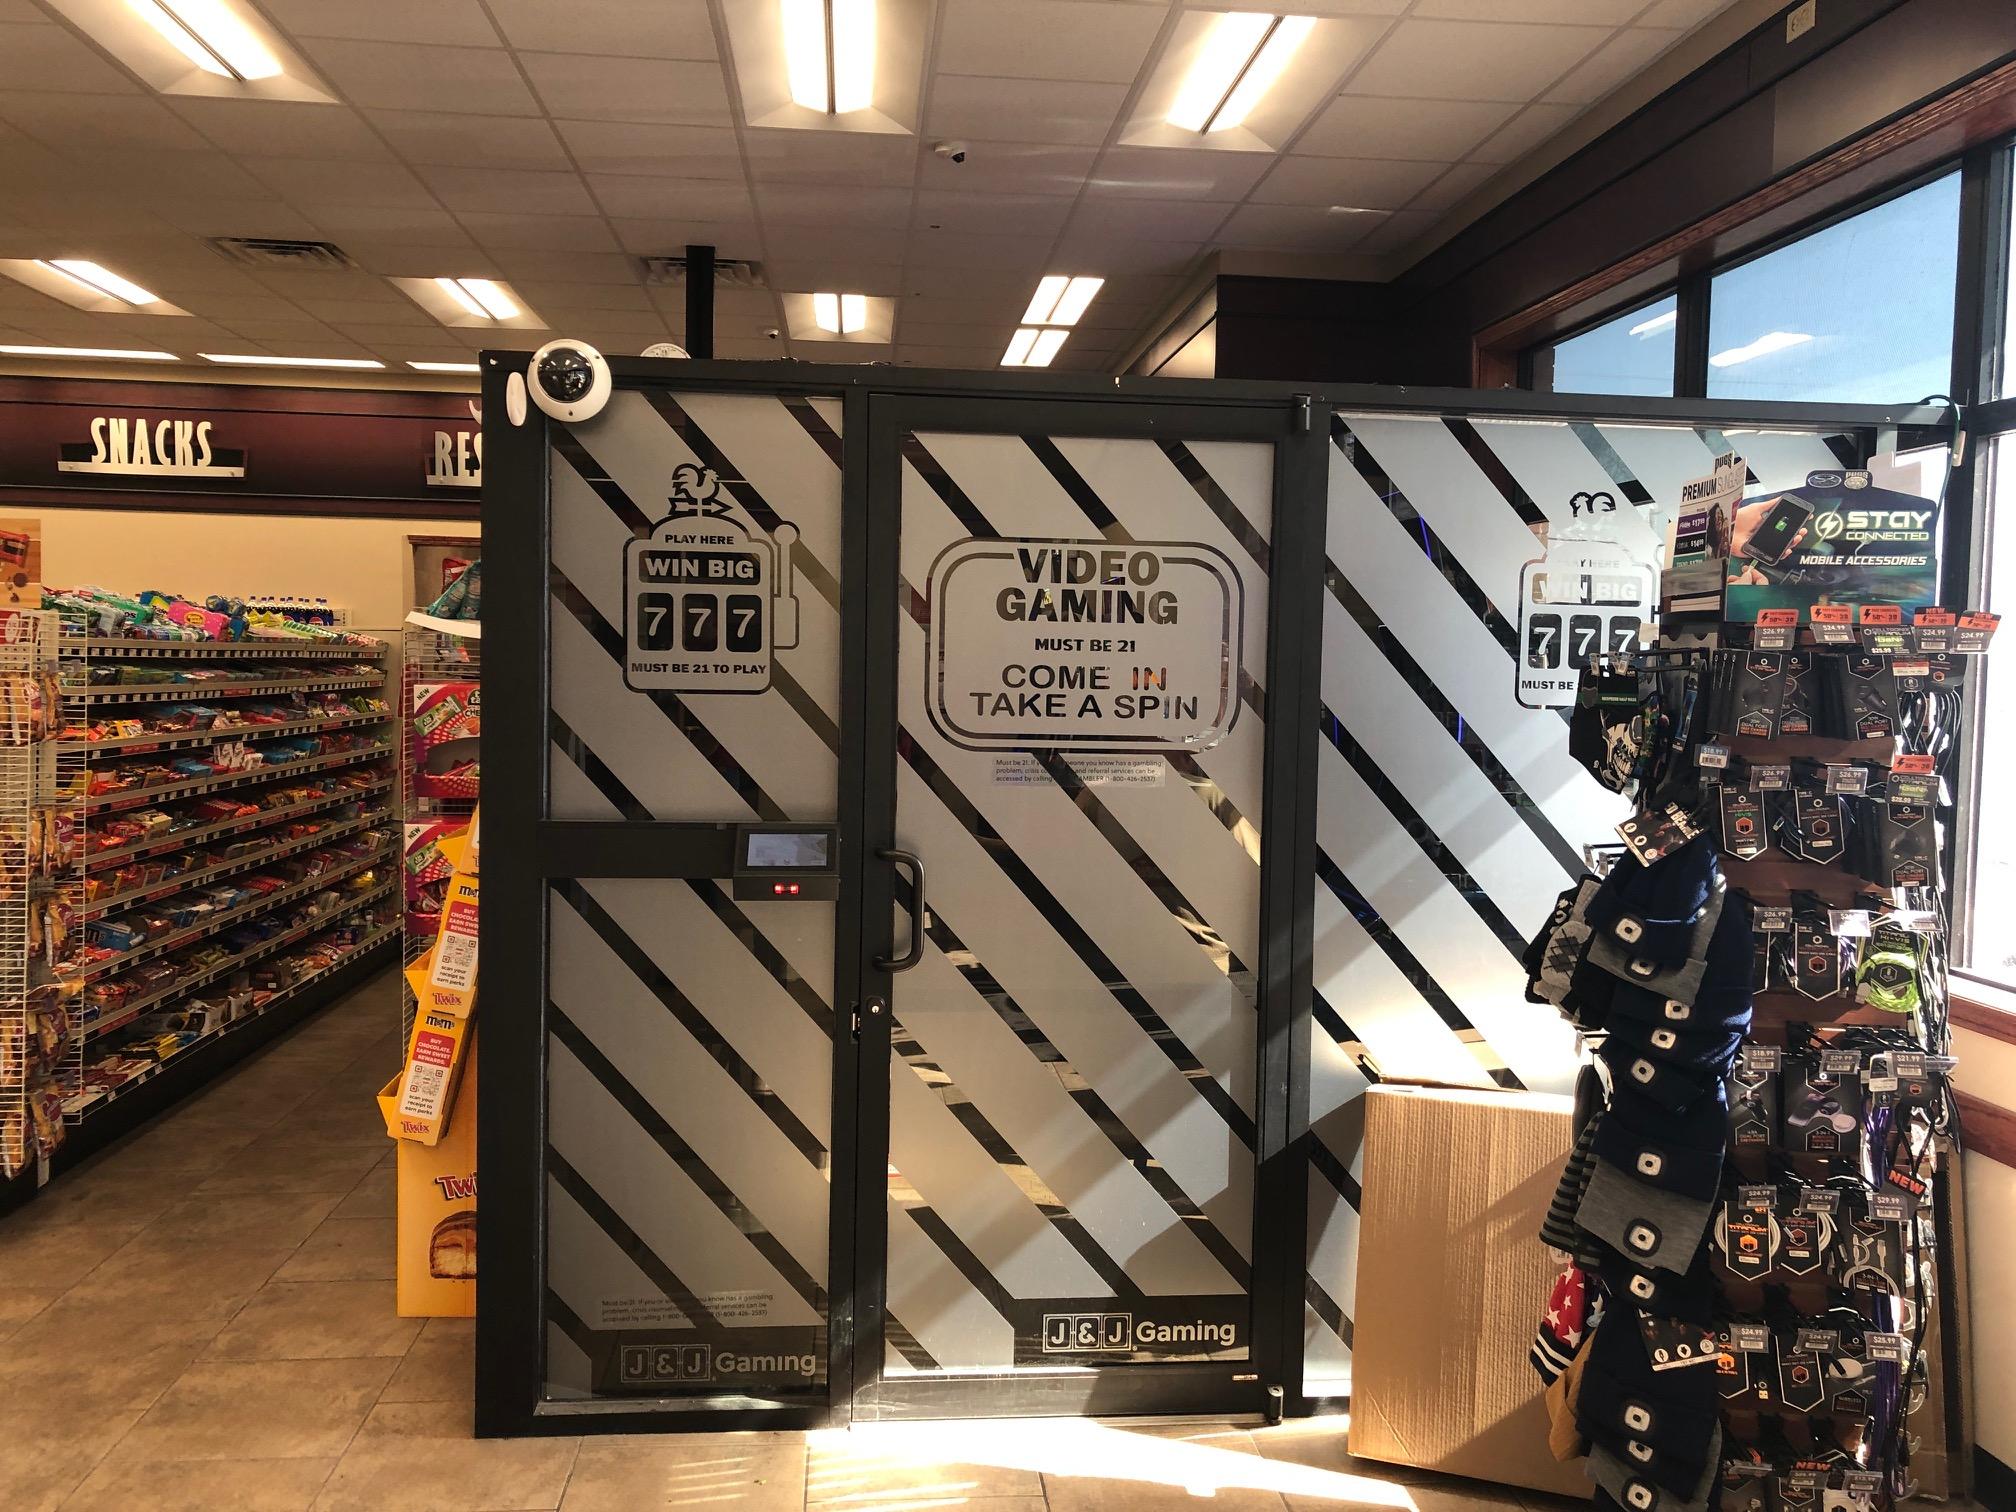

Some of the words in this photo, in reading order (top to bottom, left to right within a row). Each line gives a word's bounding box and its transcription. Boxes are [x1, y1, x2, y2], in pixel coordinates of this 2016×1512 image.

[90, 417, 212, 467] SNACKS
[1682, 477, 1717, 502] PREMIUM
[665, 534, 697, 544] PLAY
[700, 535, 734, 545] HERE
[1846, 531, 1929, 541] CONNECTED
[645, 558, 699, 577] WIN
[708, 560, 754, 578] BIG
[1017, 548, 1160, 586] VIDEO
[1800, 555, 1844, 565] MOBILE
[1845, 555, 1928, 566] ACCESSORIES
[1597, 582, 1637, 600] BIG
[996, 587, 1178, 625] GAMING
[644, 607, 667, 637] 7
[688, 608, 711, 637] 7
[733, 609, 756, 638] 7
[1035, 638, 1084, 652] MUST
[1090, 640, 1112, 652] BE
[1118, 640, 1136, 652] 21
[1534, 627, 1556, 654] 7
[1574, 628, 1596, 656] 7
[1614, 629, 1636, 652] 7
[631, 663, 669, 673] MUST
[672, 663, 689, 673] BE
[693, 664, 710, 673] 21
[713, 664, 730, 673] TO
[733, 664, 766, 674] PLAY
[1002, 664, 1110, 690] COME
[1133, 667, 1167, 691] IN
[416, 688, 430, 700] NEW
[1521, 680, 1555, 690] MUST
[1558, 680, 1574, 690] BE
[969, 692, 1067, 717] TAKE
[1077, 694, 1102, 718] A
[1113, 695, 1198, 719] SPIN
[407, 826, 421, 840] NEW
[433, 993, 462, 1006] Twix
[401, 1120, 430, 1134] Twix
[1888, 1169, 1926, 1195] NEW
[1877, 1196, 1900, 1204] $29.99
[1136, 1319, 1236, 1346] Gaming
[715, 1352, 816, 1376] Gaming
[1796, 1461, 1831, 1471] NEW
